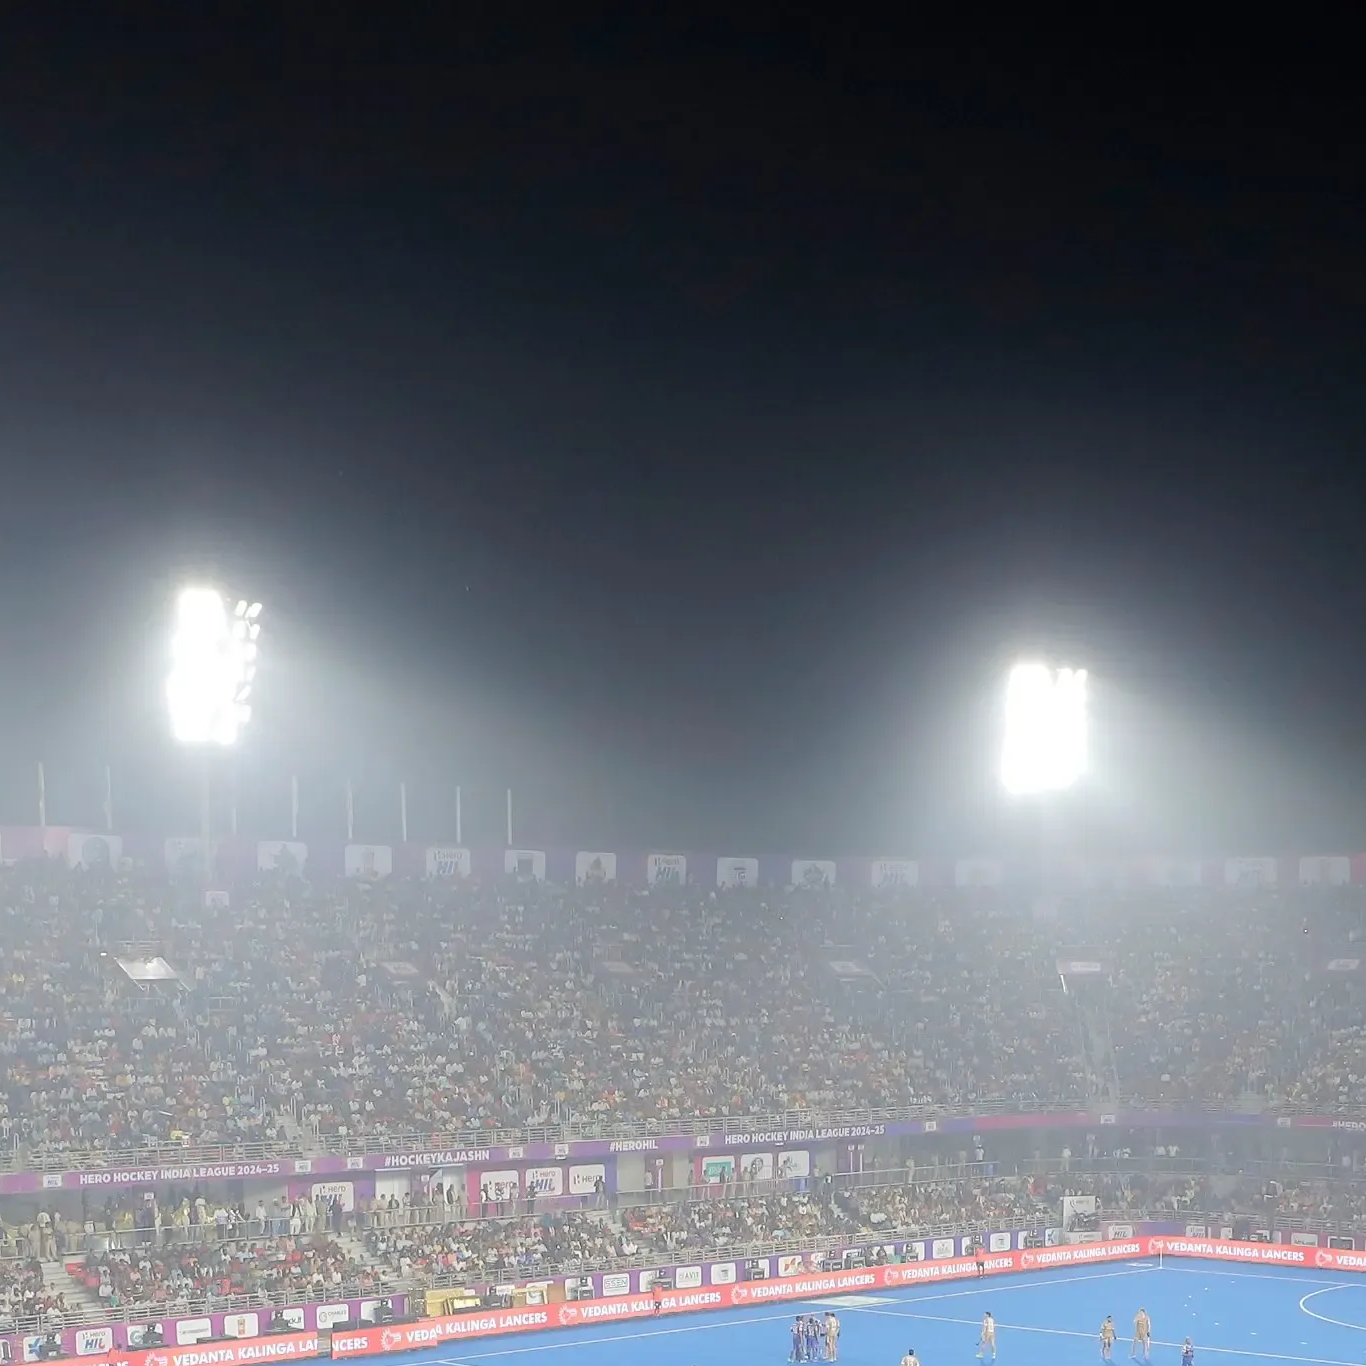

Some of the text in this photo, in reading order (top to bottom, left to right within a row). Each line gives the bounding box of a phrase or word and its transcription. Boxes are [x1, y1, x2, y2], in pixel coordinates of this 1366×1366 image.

[609, 1139, 659, 1152] #HEROHIL
[725, 1134, 750, 1144] HERO
[752, 1131, 788, 1143] HOCKEY
[789, 1129, 814, 1140] INDIA
[816, 1127, 849, 1138] LEAGUE
[384, 1149, 490, 1167] #HOCKEYKAJASHN
[80, 1173, 111, 1185] HERO
[113, 1170, 158, 1183] HOCKEY
[160, 1167, 191, 1181] INDIA
[193, 1165, 236, 1178] LEAGUE
[1036, 1243, 1140, 1263] VEDANTA KALINGA LANCERS
[1166, 1242, 1305, 1262] VEDANTA KALINGA LANCERS
[901, 1267, 940, 1280] VEDANTA
[942, 1262, 977, 1275] KALINGA
[751, 1274, 875, 1298] VEDANTA KALINGA LANCERS
[580, 1291, 722, 1318] VEDANTA KALIGA LANCERS
[446, 1317, 497, 1334] KALINGA
[499, 1311, 548, 1329] LANCERS
[238, 1342, 296, 1359] KALINGA
